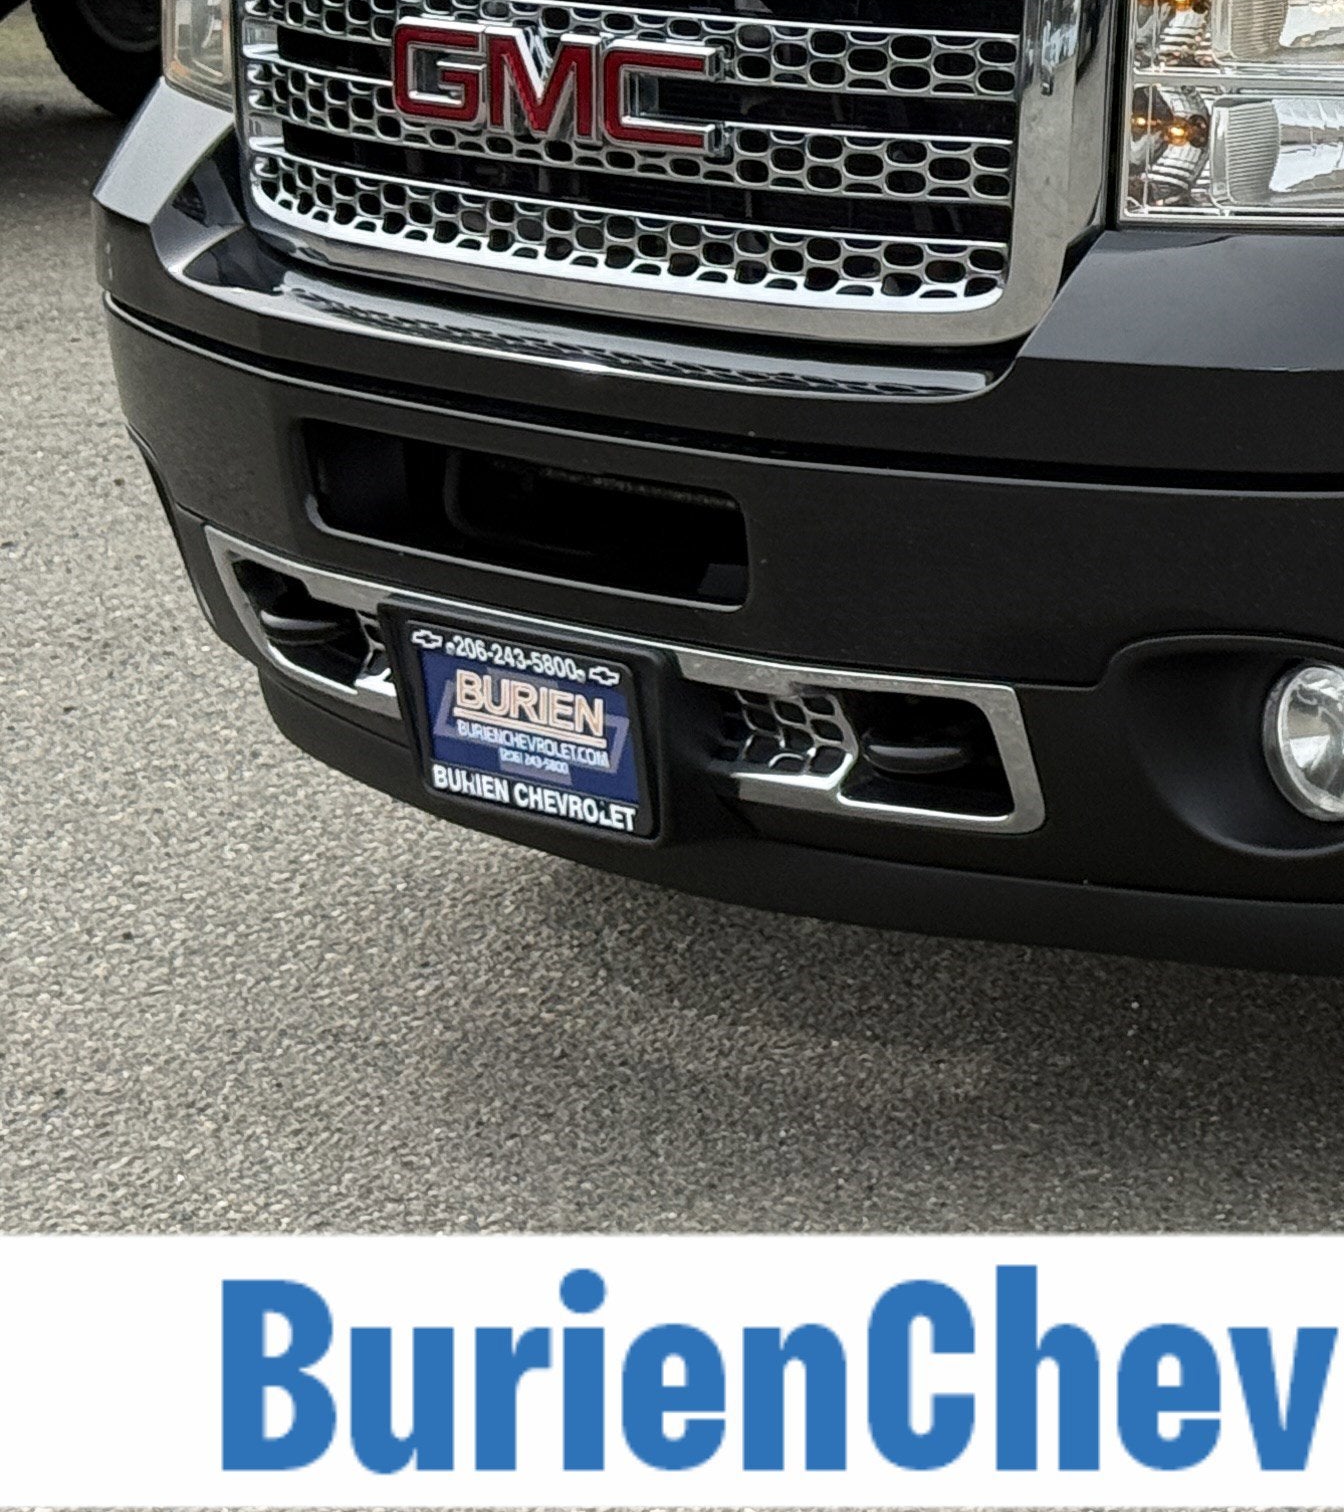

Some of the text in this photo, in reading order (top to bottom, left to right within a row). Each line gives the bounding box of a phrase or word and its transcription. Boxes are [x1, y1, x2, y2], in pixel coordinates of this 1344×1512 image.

[393, 16, 725, 156] GMC
[452, 635, 578, 681] 206-243-5800
[455, 668, 605, 737] BURIEN
